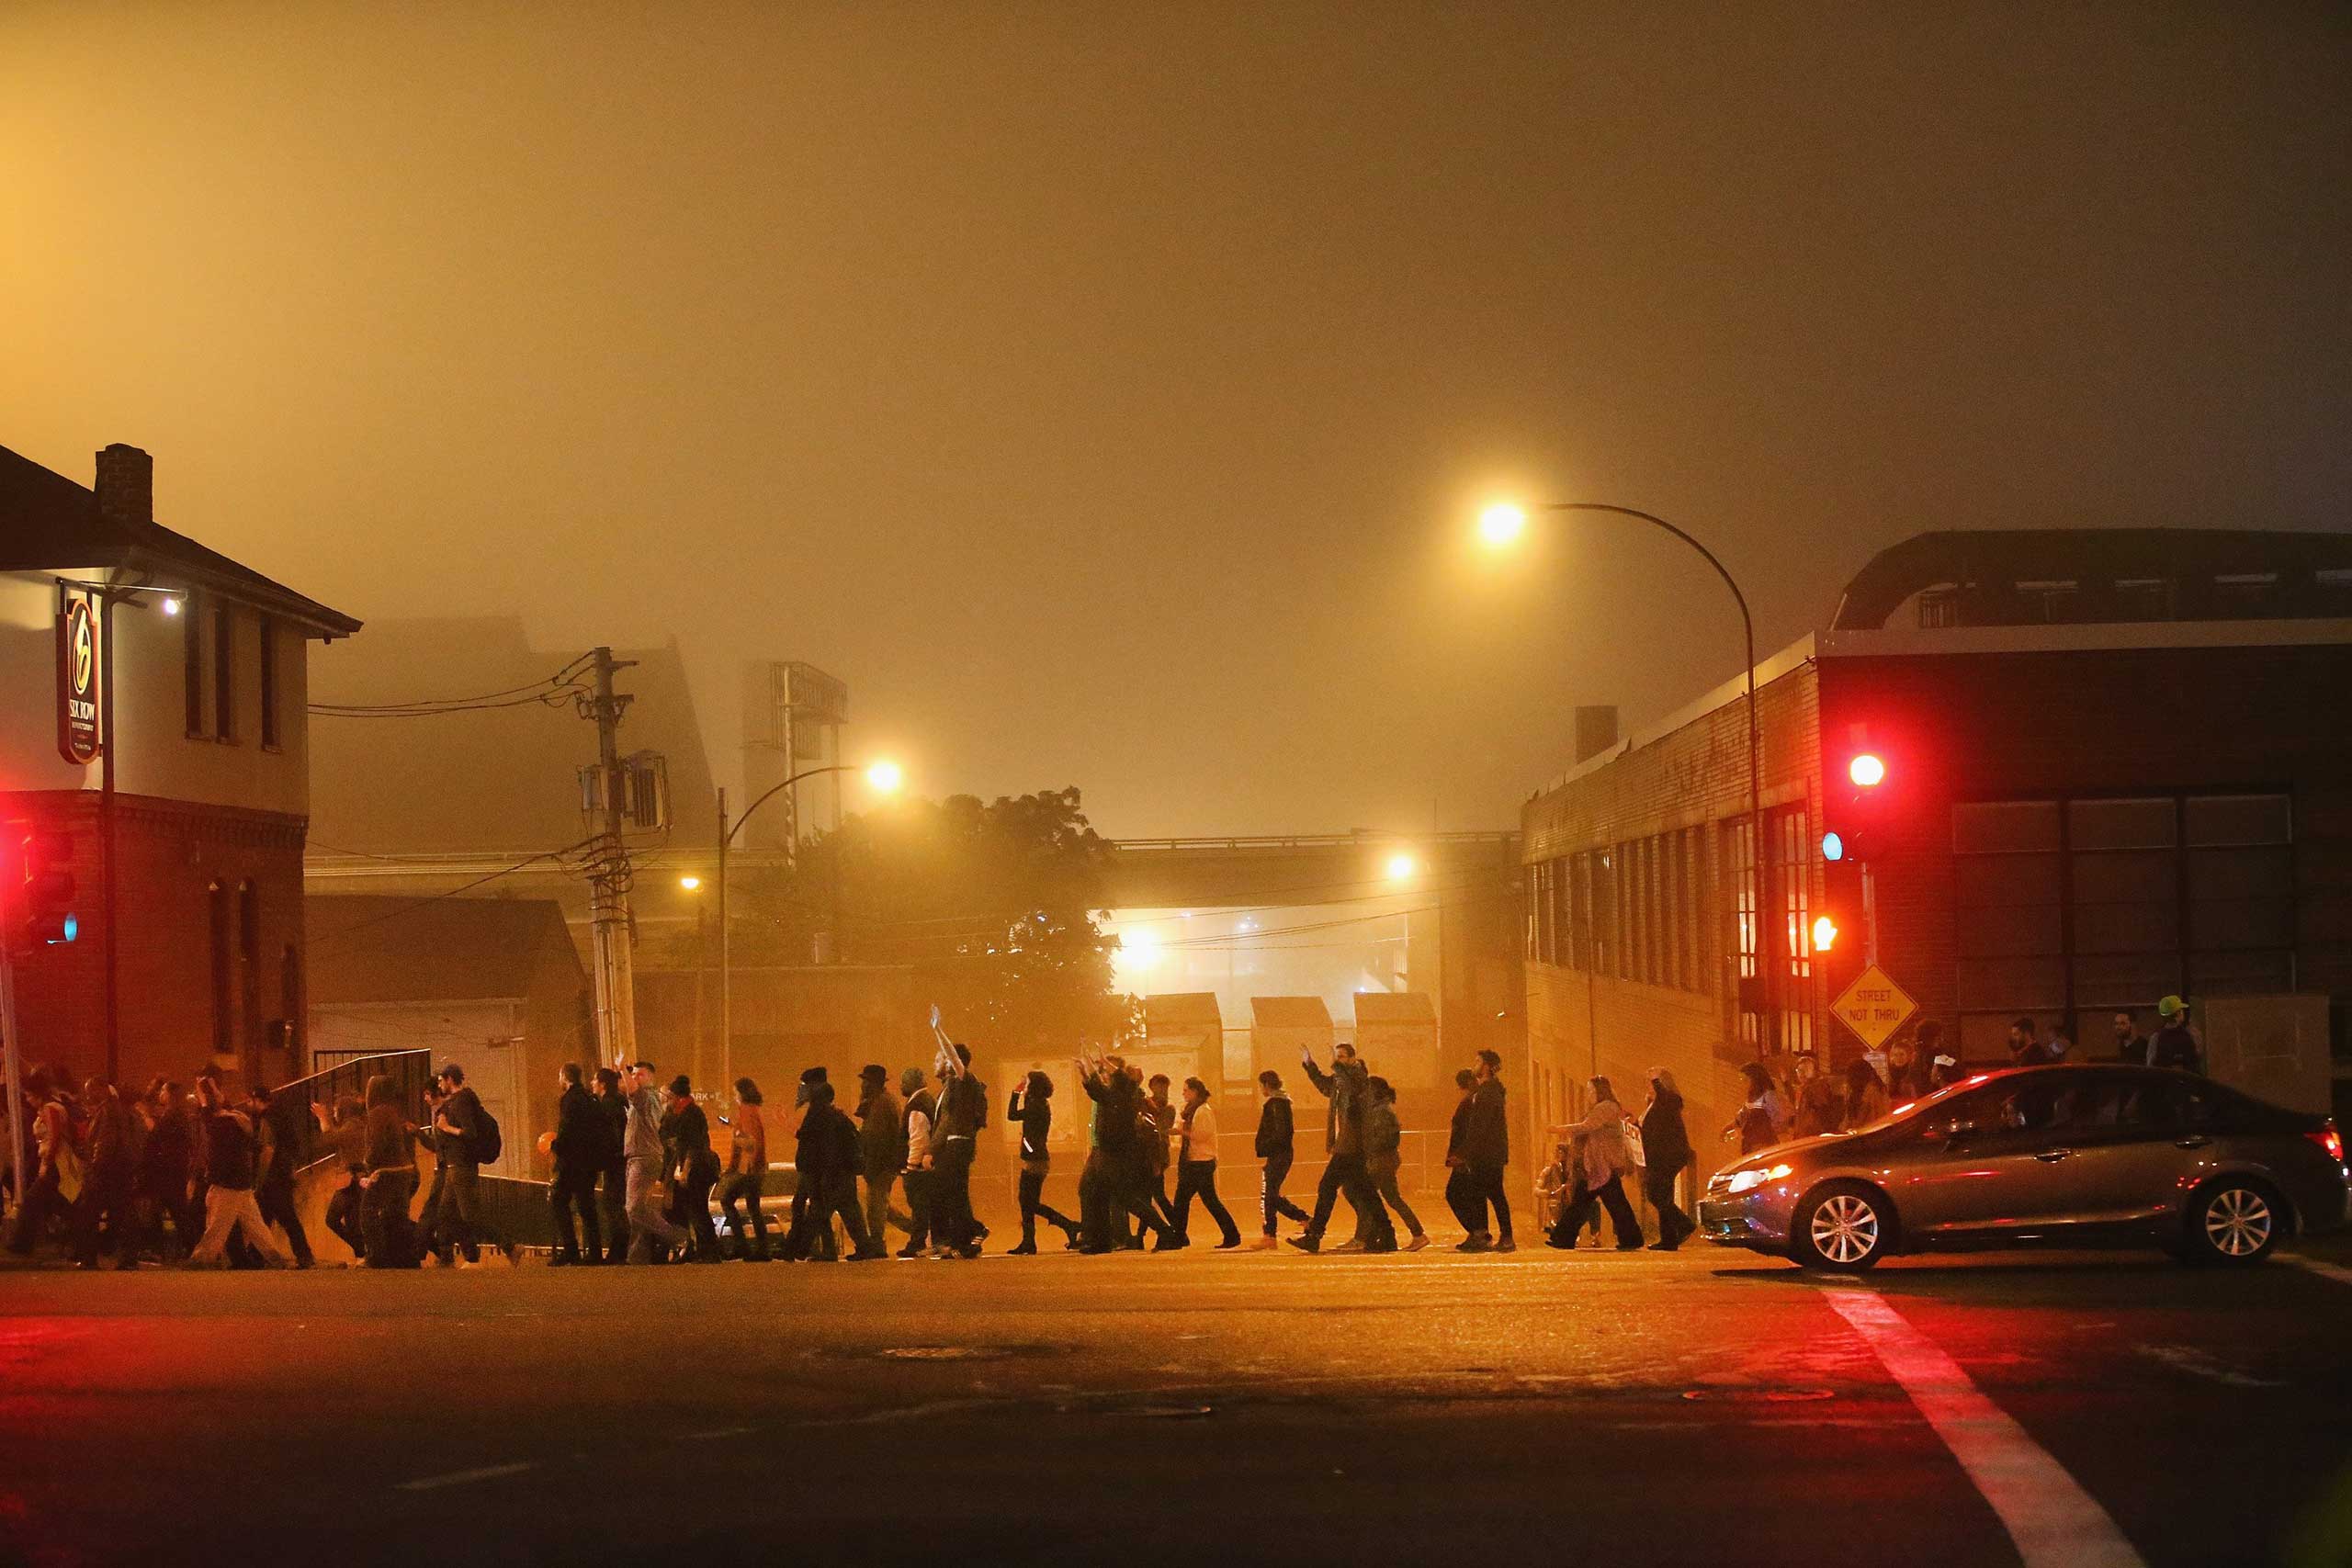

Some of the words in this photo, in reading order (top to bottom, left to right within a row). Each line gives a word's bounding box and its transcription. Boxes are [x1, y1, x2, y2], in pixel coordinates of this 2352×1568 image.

[69, 699, 80, 718] SIX
[80, 701, 96, 721] ROW
[1856, 989, 1891, 1001] STREET
[1849, 1009, 1867, 1021] NOT
[1874, 1009, 1899, 1021] THRU
